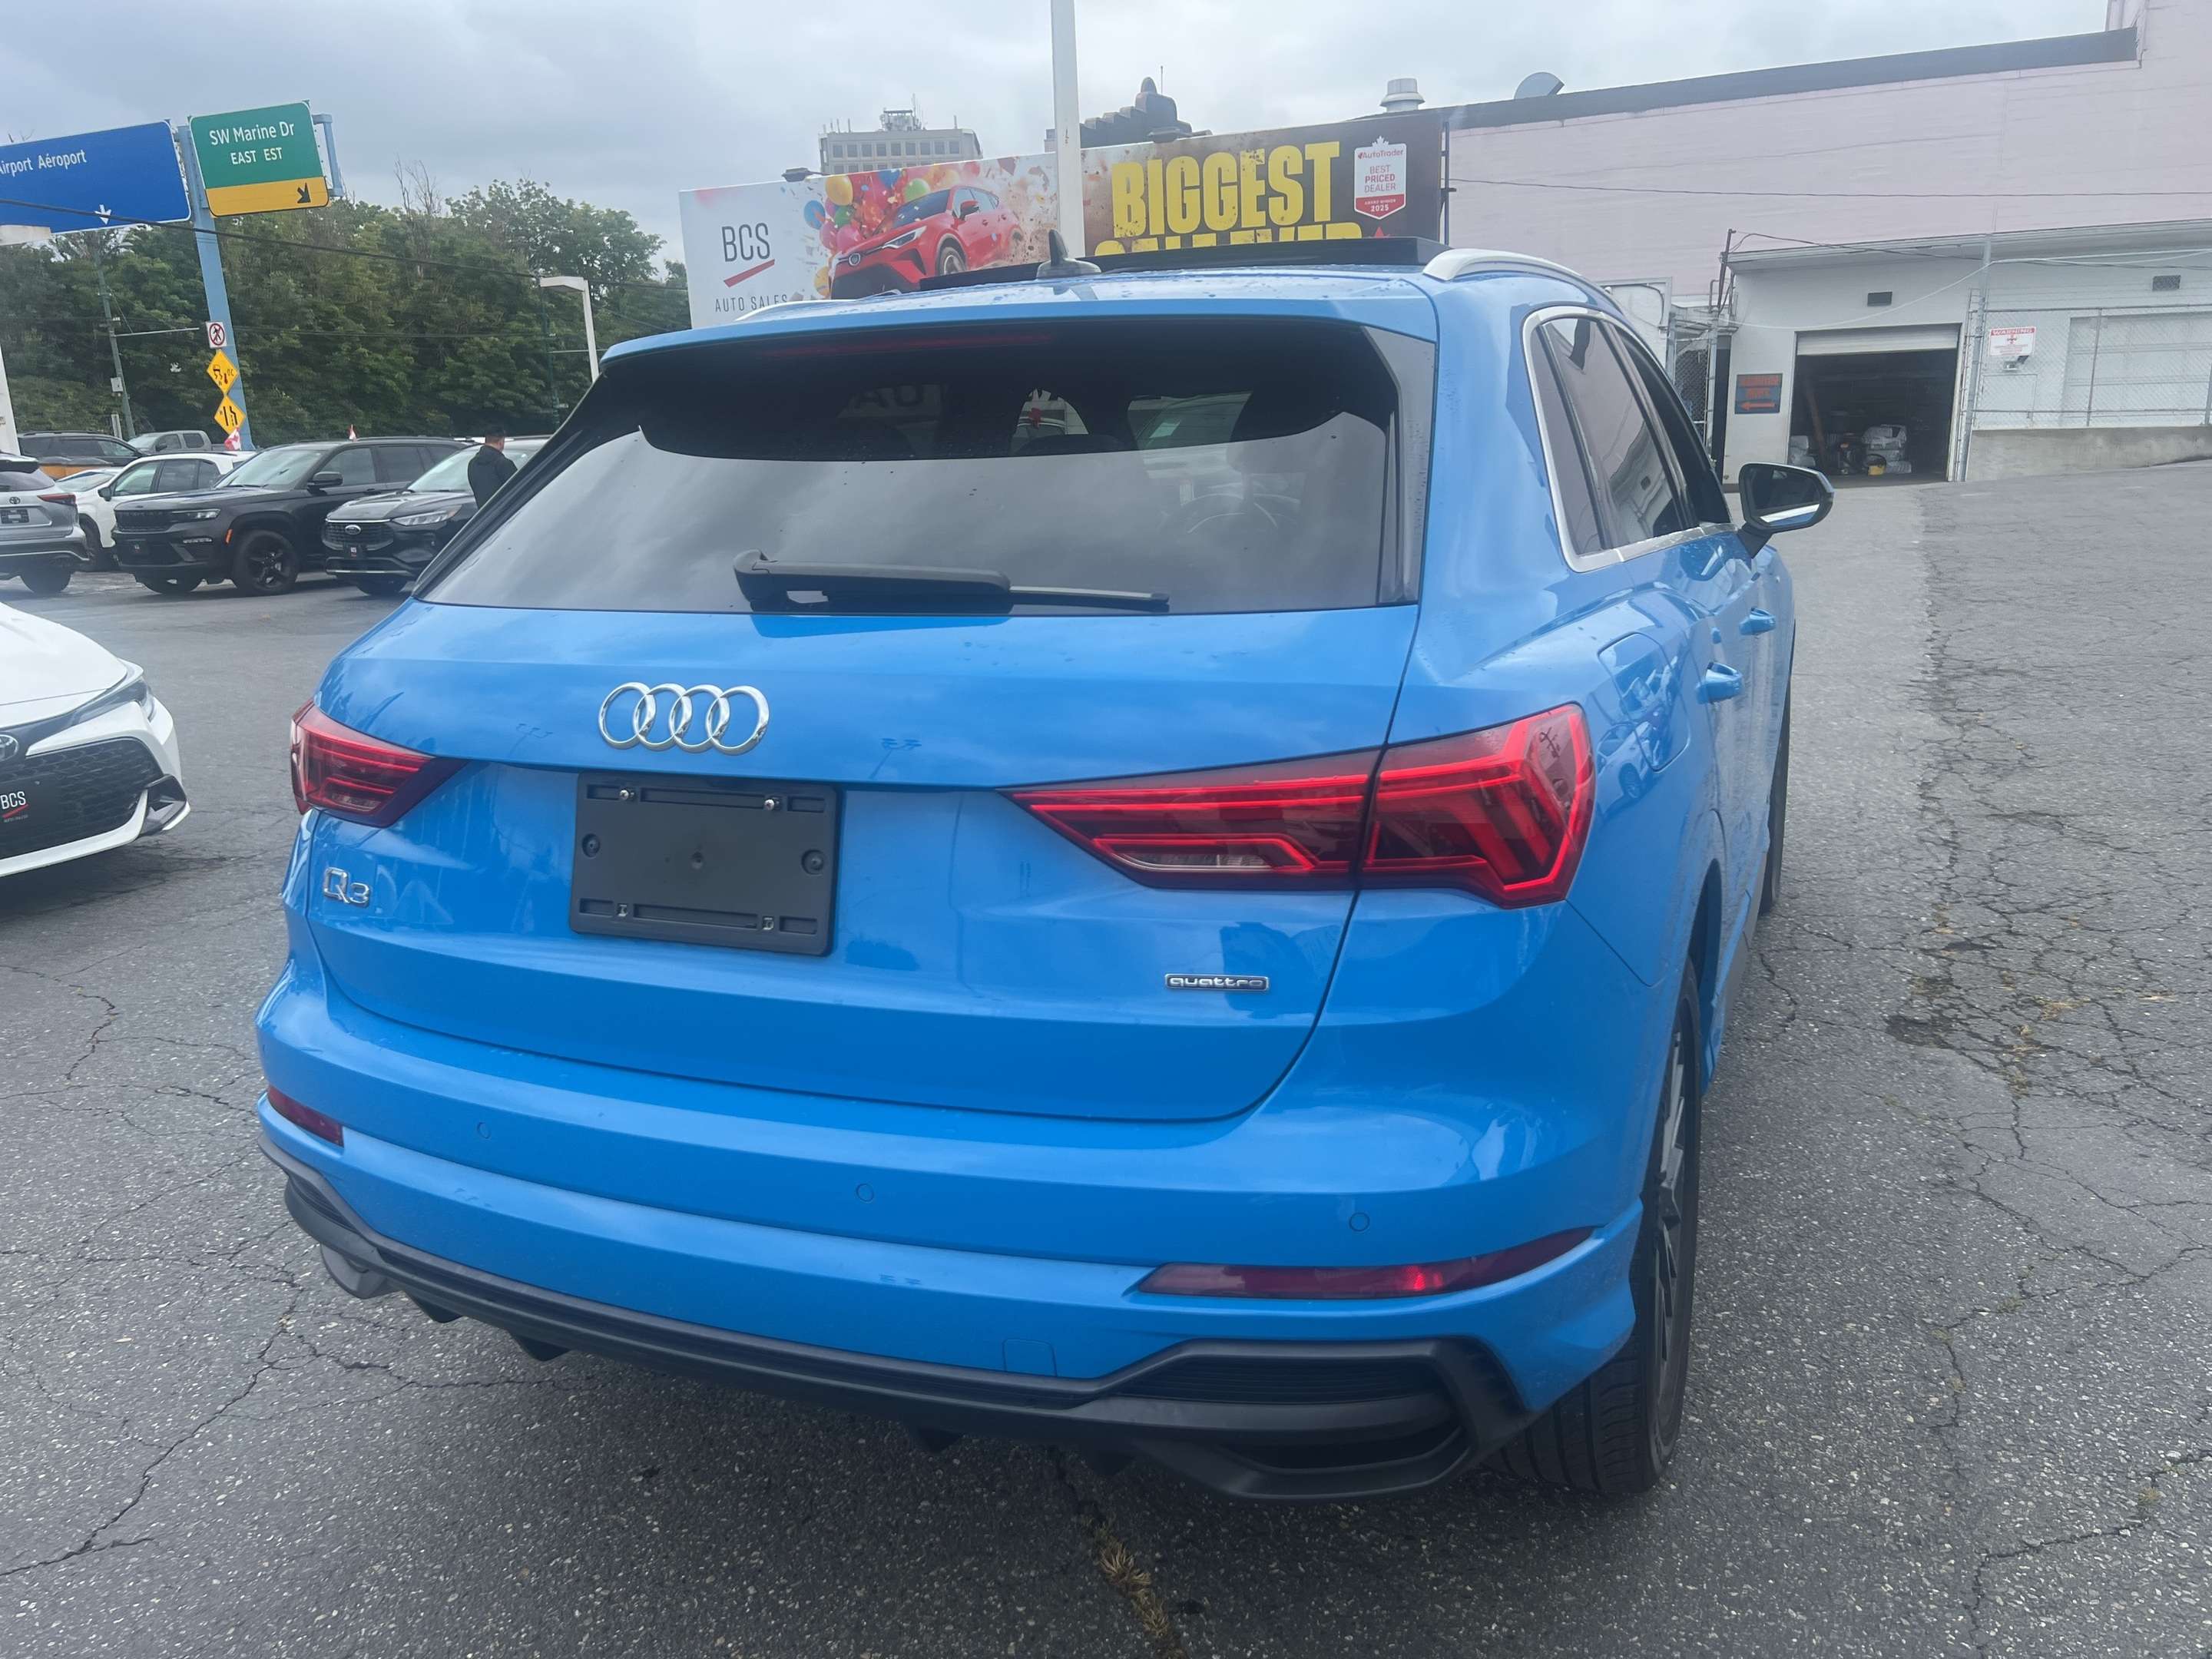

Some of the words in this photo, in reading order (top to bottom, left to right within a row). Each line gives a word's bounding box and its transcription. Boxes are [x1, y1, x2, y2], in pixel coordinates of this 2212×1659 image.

[209, 128, 230, 146] SW
[233, 124, 277, 143] Marine
[279, 121, 294, 137] Dr
[38, 149, 87, 170] Aéroport
[230, 150, 257, 165] EAST
[263, 147, 282, 161] EST
[1369, 164, 1391, 174] BEST
[1364, 174, 1396, 184] PRICED
[1364, 183, 1396, 194] DEALER
[1112, 141, 1340, 238] BIGGEST
[721, 222, 770, 262] BCS
[714, 296, 744, 313] AUTO
[0, 790, 26, 810] BCS
[324, 866, 371, 907] Q3
[1170, 977, 1263, 987] quattro
